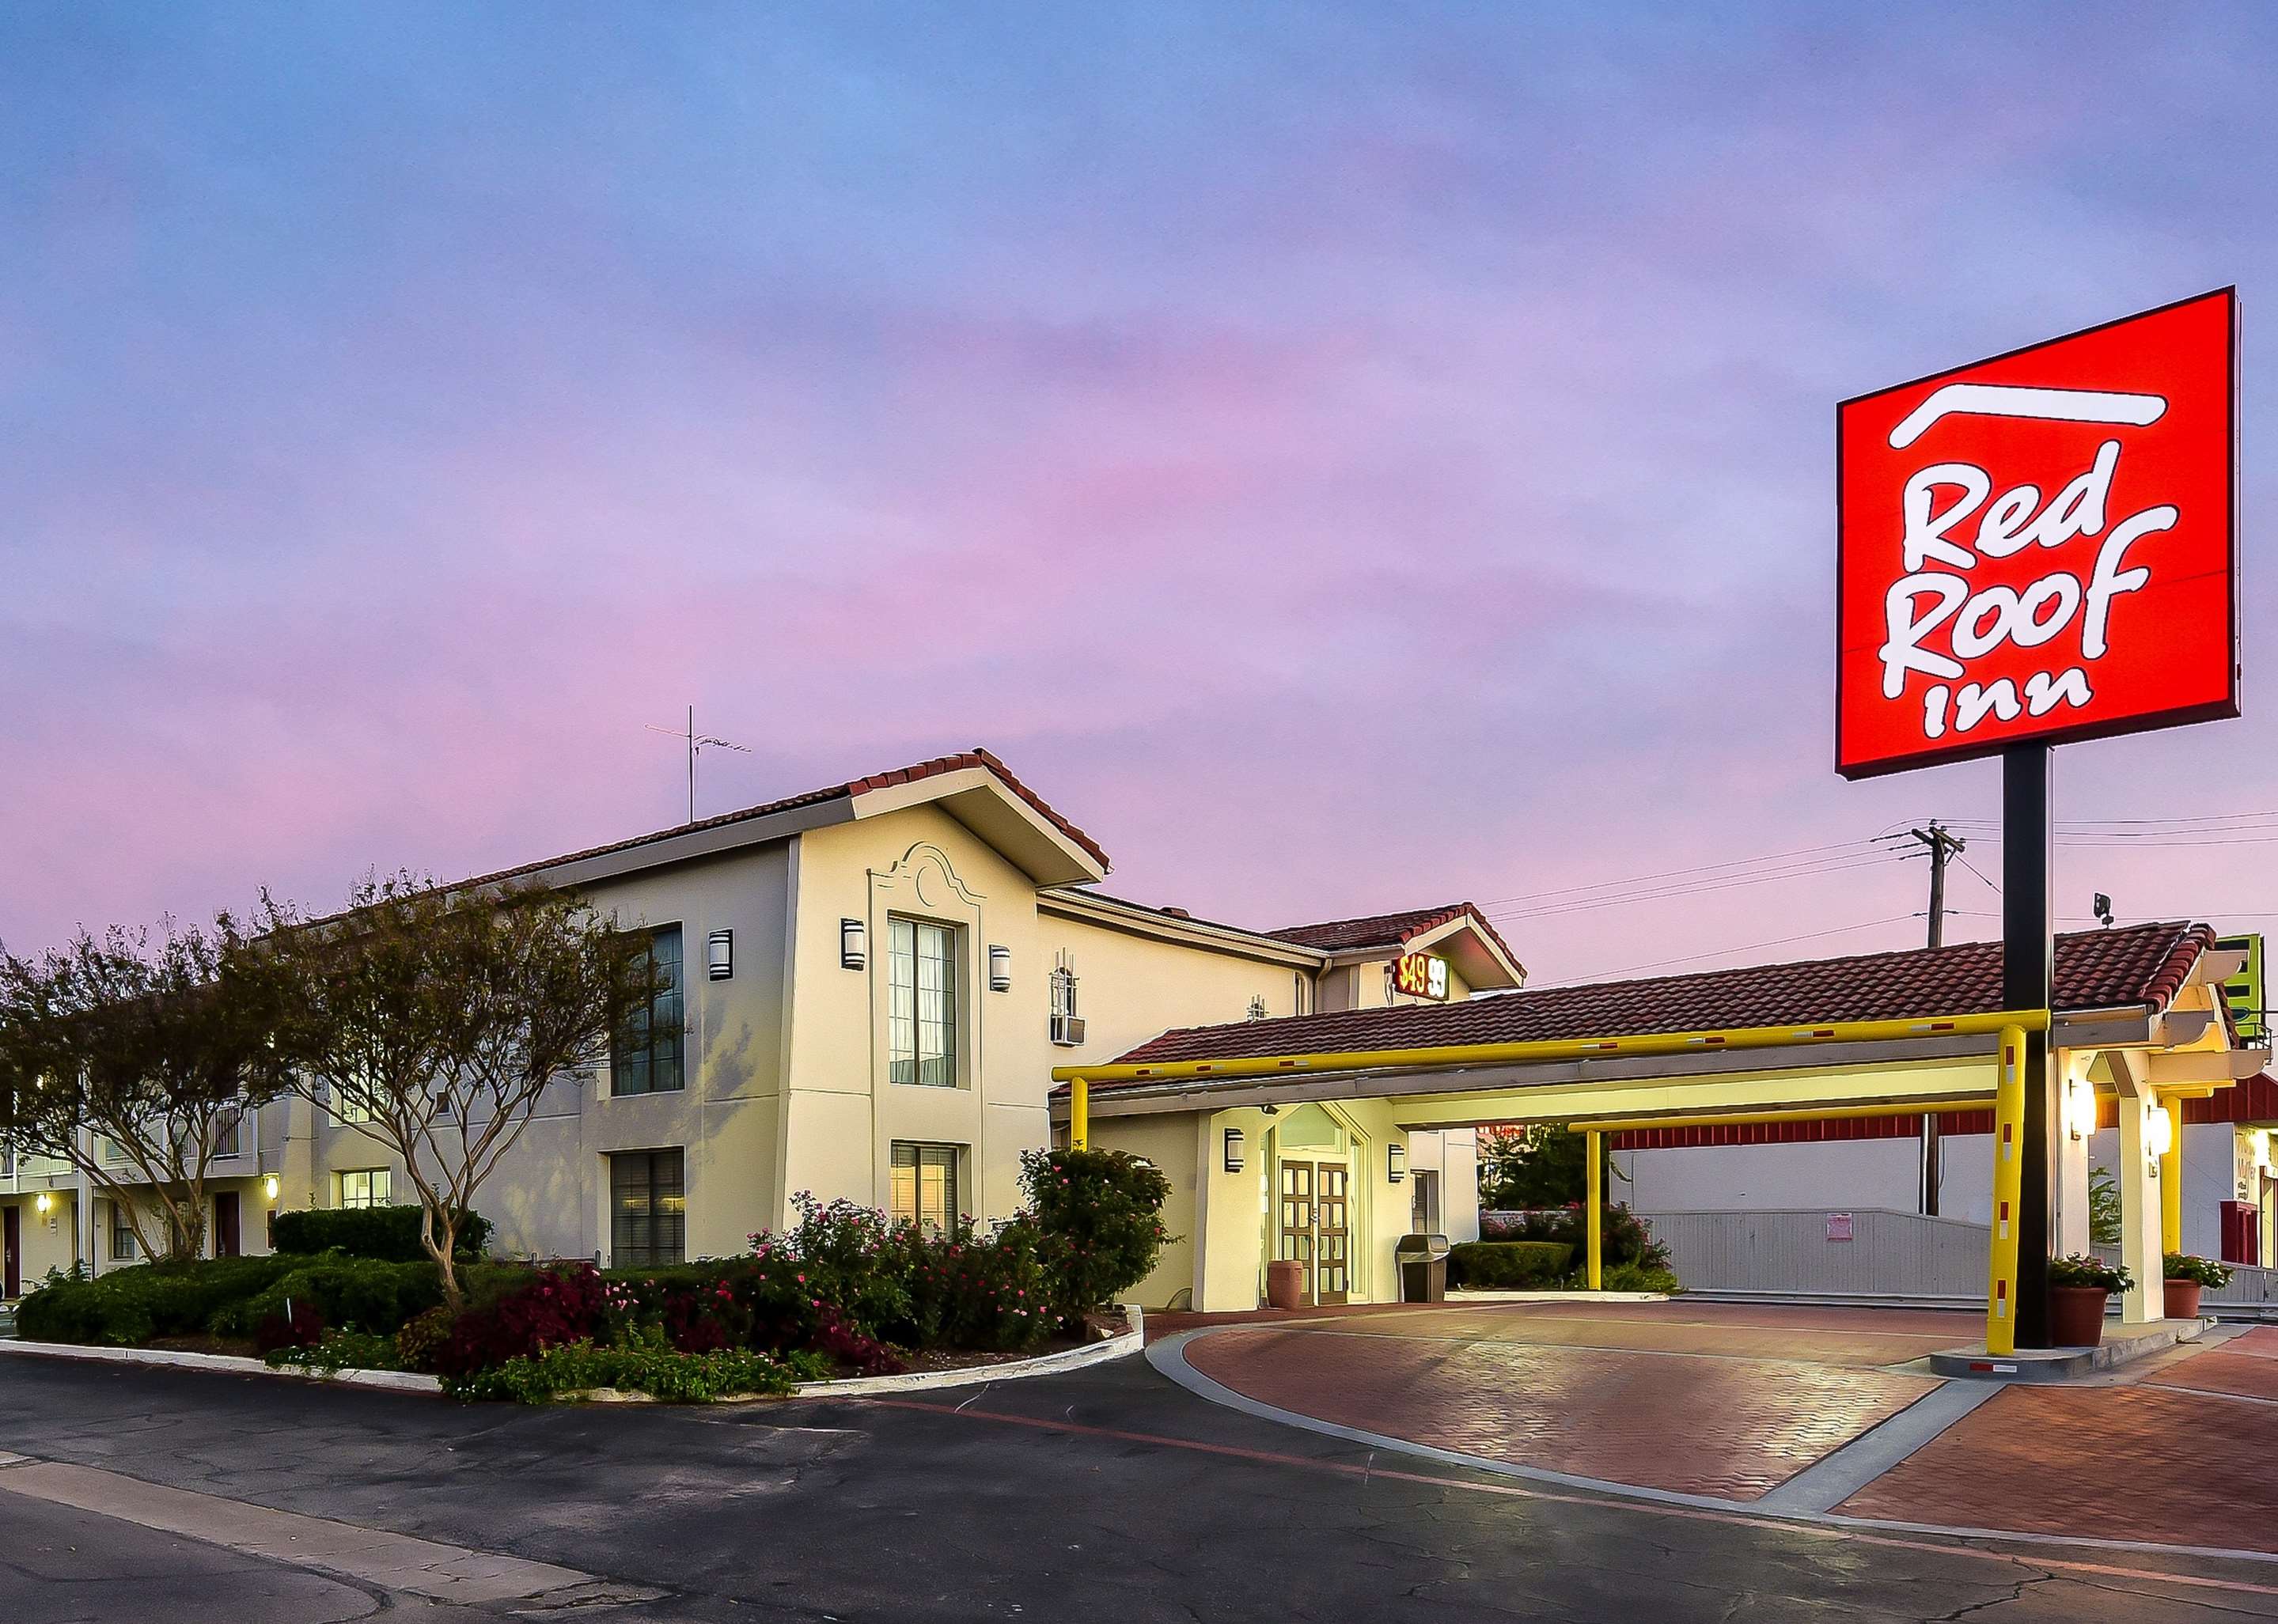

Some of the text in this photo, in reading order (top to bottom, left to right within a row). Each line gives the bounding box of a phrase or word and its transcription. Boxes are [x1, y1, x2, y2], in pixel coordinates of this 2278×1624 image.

[1902, 439, 2122, 574] Red
[1878, 505, 2178, 698] Roof
[1923, 666, 2095, 739] inn
[1400, 955, 1425, 993] $49
